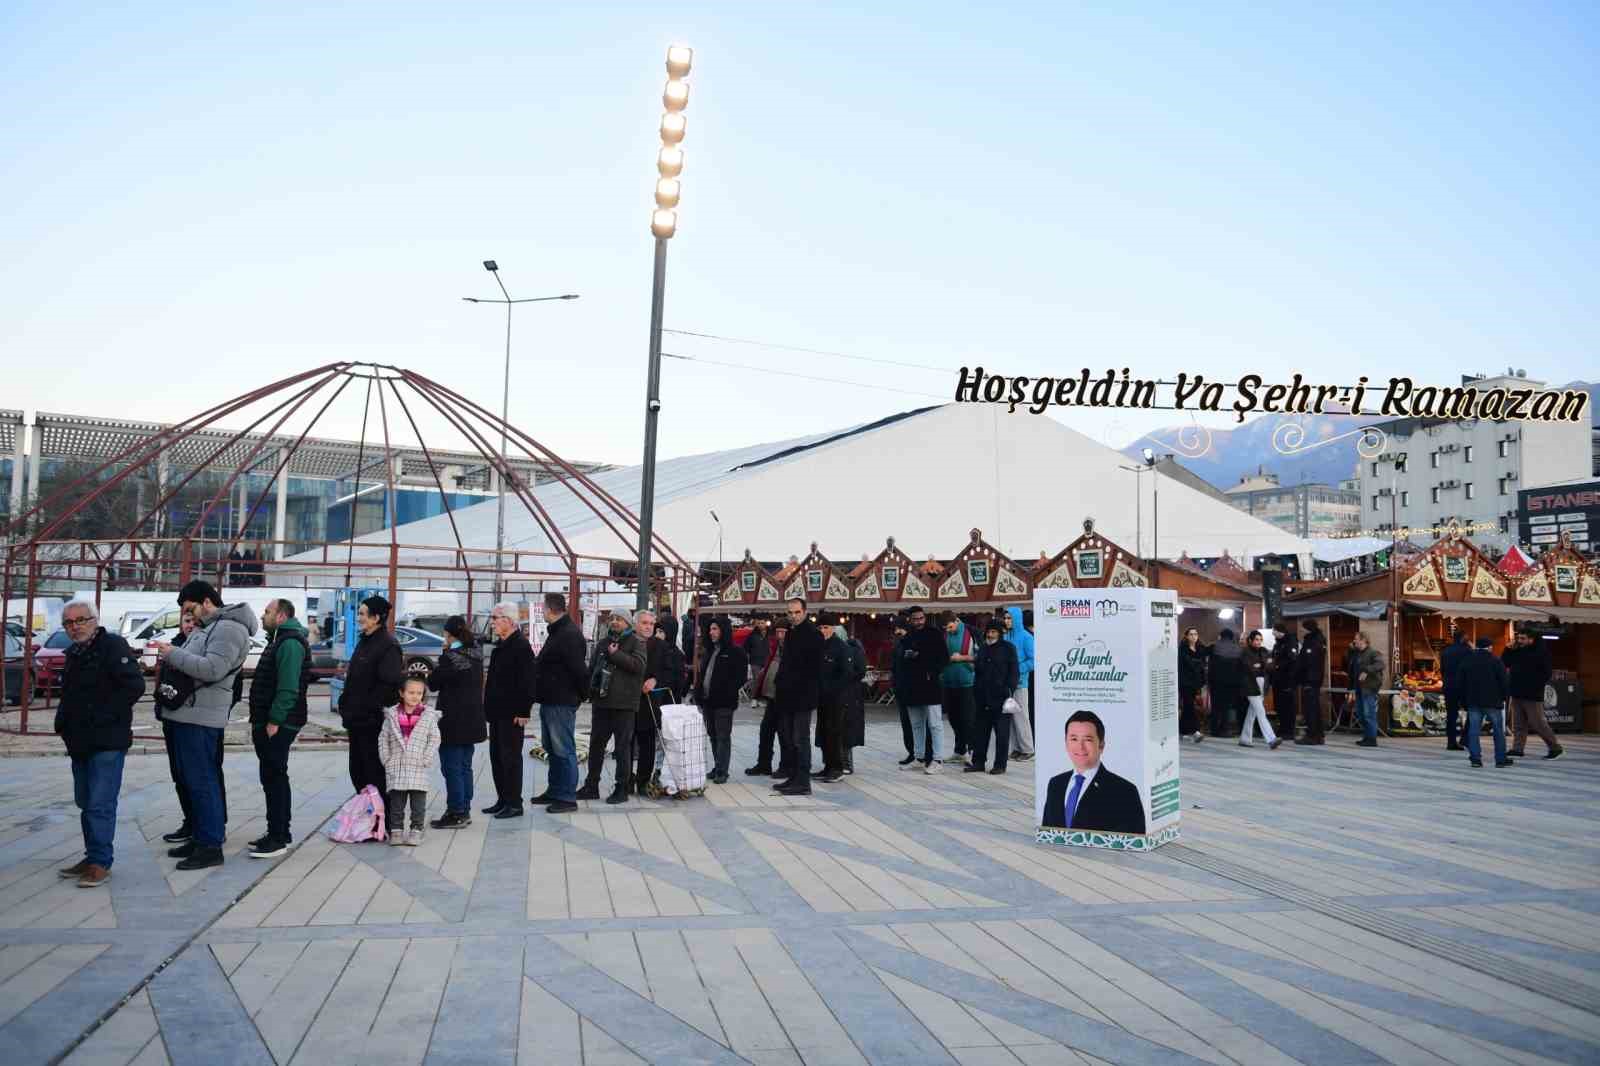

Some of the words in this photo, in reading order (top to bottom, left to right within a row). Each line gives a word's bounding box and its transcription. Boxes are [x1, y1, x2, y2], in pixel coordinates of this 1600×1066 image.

[954, 366, 1156, 415] Hoşgeldin
[1174, 372, 1224, 410] Ya
[1233, 373, 1370, 423] Şehr-i
[1381, 377, 1588, 423] Ramazan
[1060, 599, 1091, 608] ERKAN
[1061, 607, 1090, 616] AYDIN
[1066, 648, 1113, 669] Hayırlı
[1049, 663, 1128, 682] Ramazanlar
